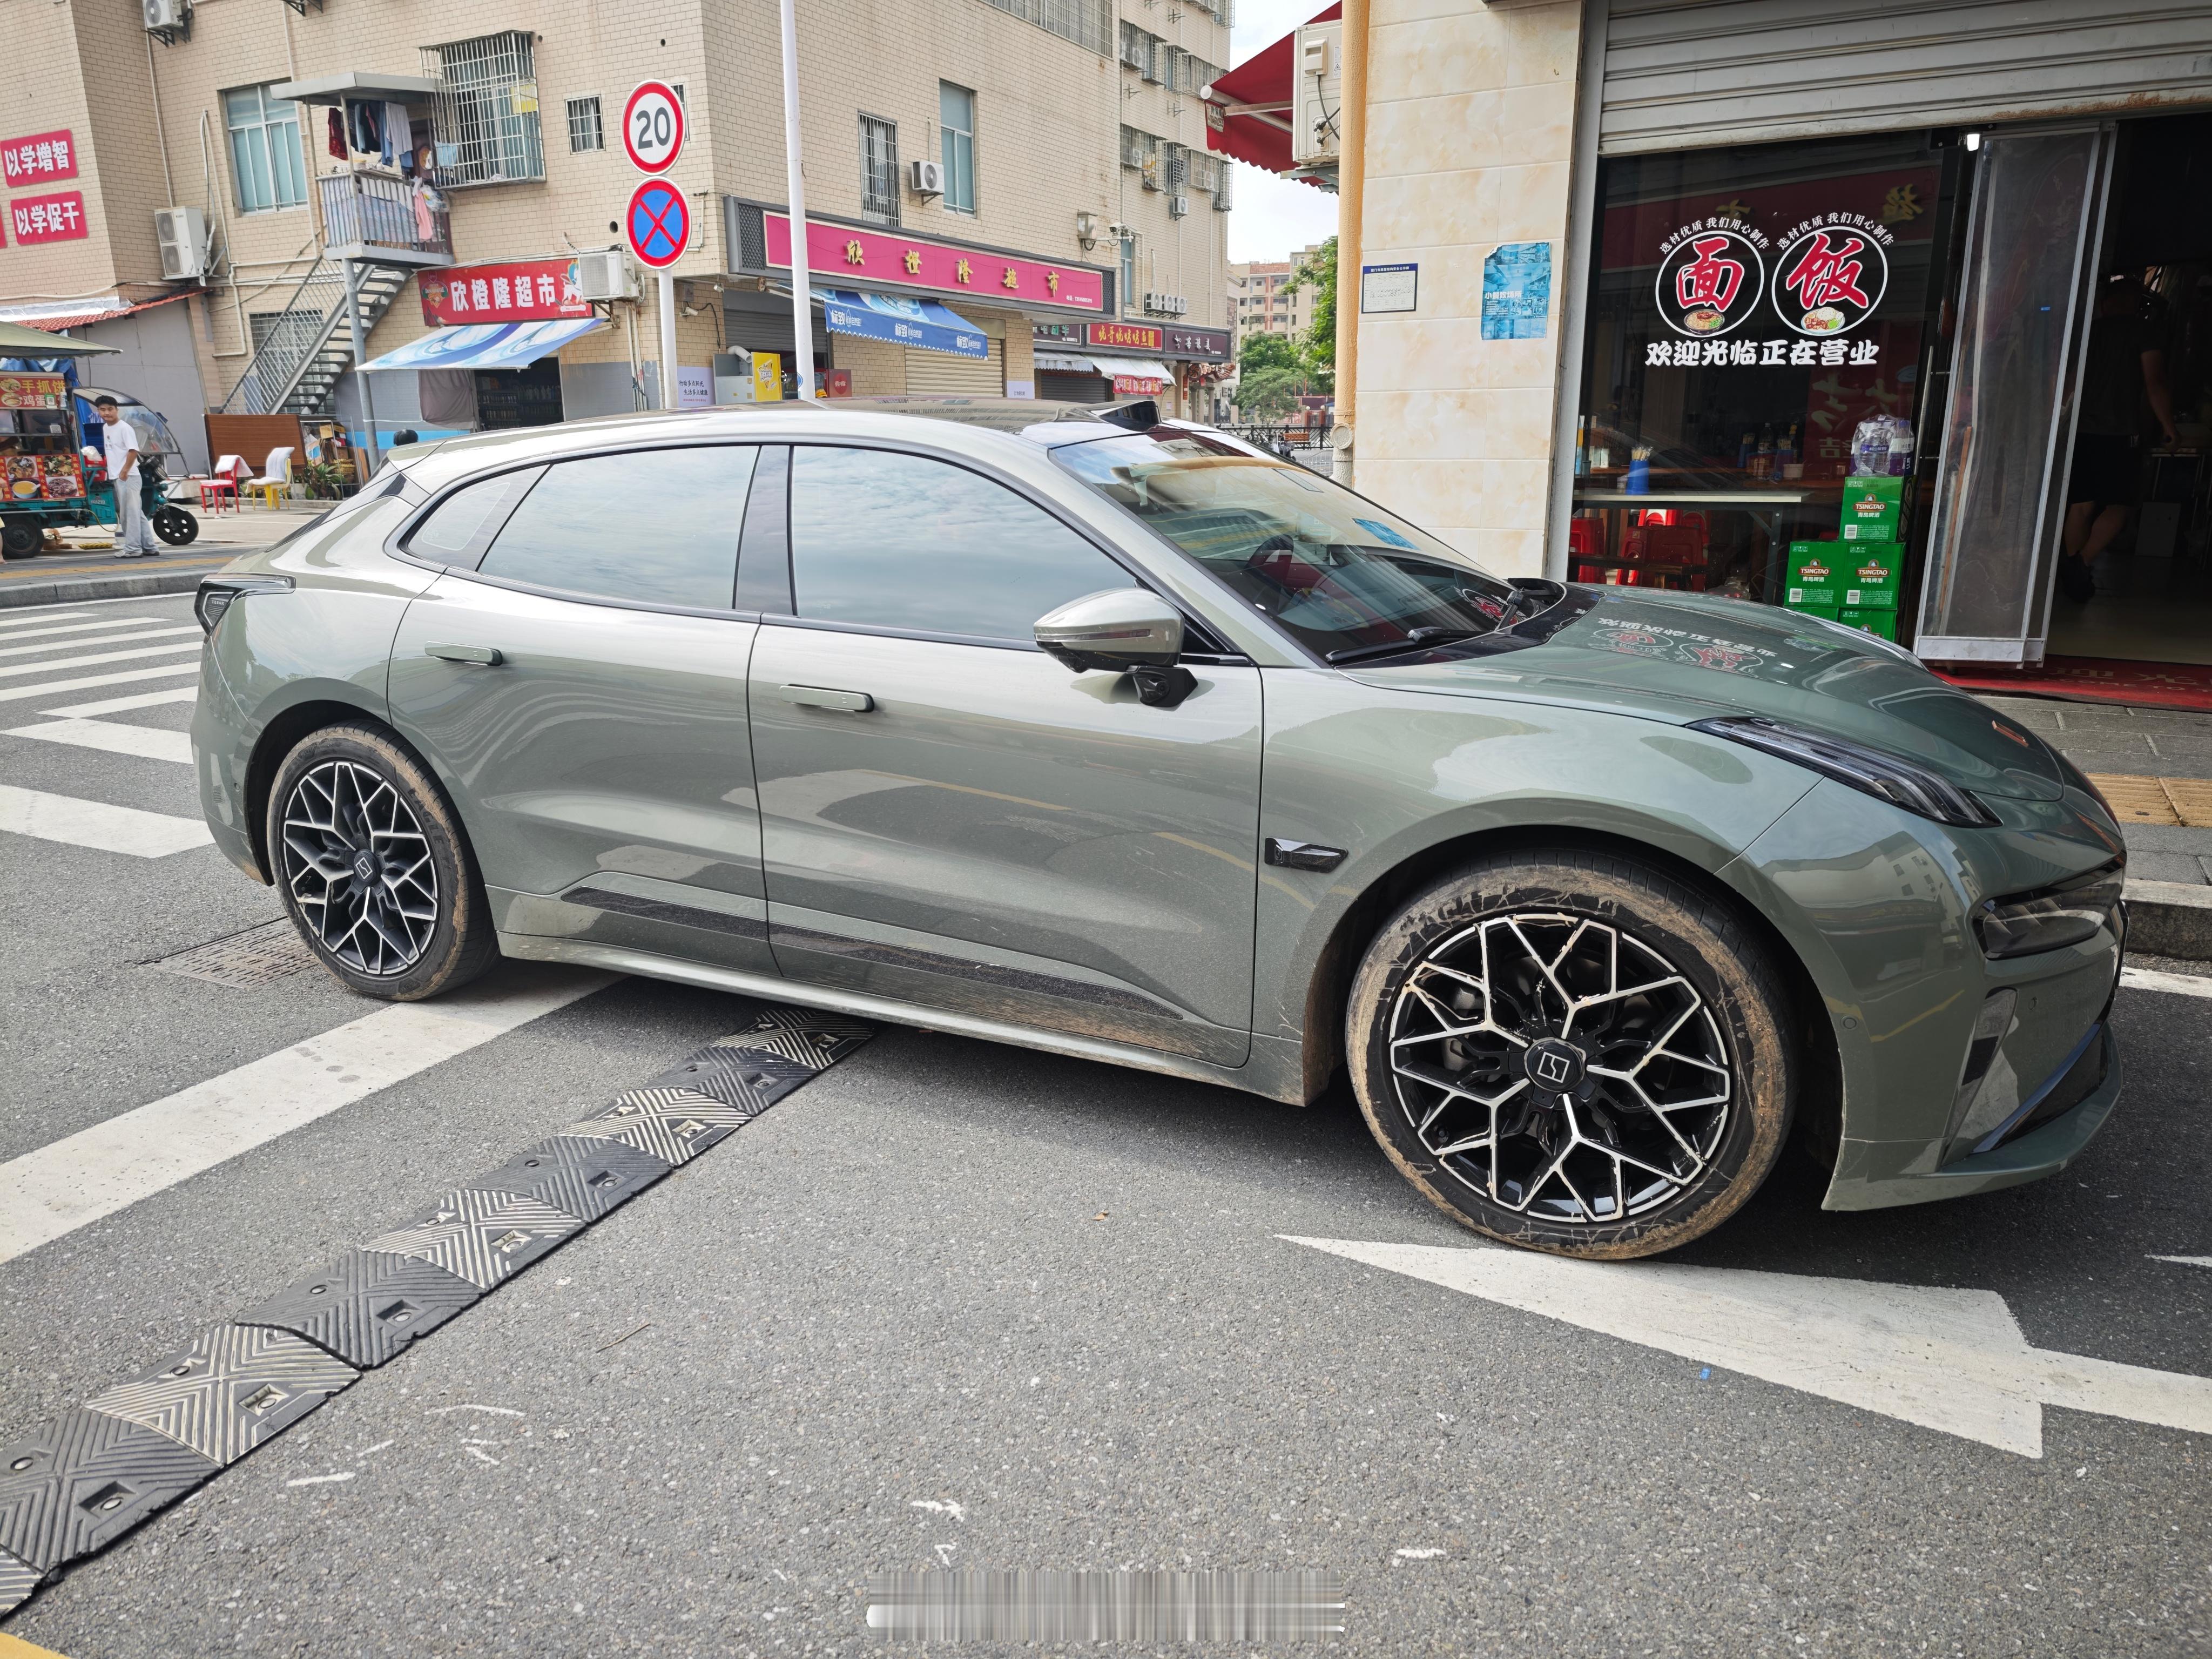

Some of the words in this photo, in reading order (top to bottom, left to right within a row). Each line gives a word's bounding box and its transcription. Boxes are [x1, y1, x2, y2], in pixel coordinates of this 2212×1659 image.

[636, 107, 671, 150] 20
[4, 140, 69, 177] 以学增智
[15, 201, 79, 236] 以学促干
[1659, 220, 1703, 254] 选材优质
[1706, 217, 1769, 249] 我们用心制作
[1777, 215, 1824, 250] 选材优质
[1827, 212, 1894, 246] 我们用心制作
[845, 240, 1060, 297] 欣橙隆超市
[1676, 237, 1745, 312] 面
[1786, 232, 1869, 310] 饭
[450, 274, 555, 312] 欣橙隆超市
[1645, 339, 1880, 367] 欢迎光临正在营业
[22, 380, 65, 395] 手抓饼
